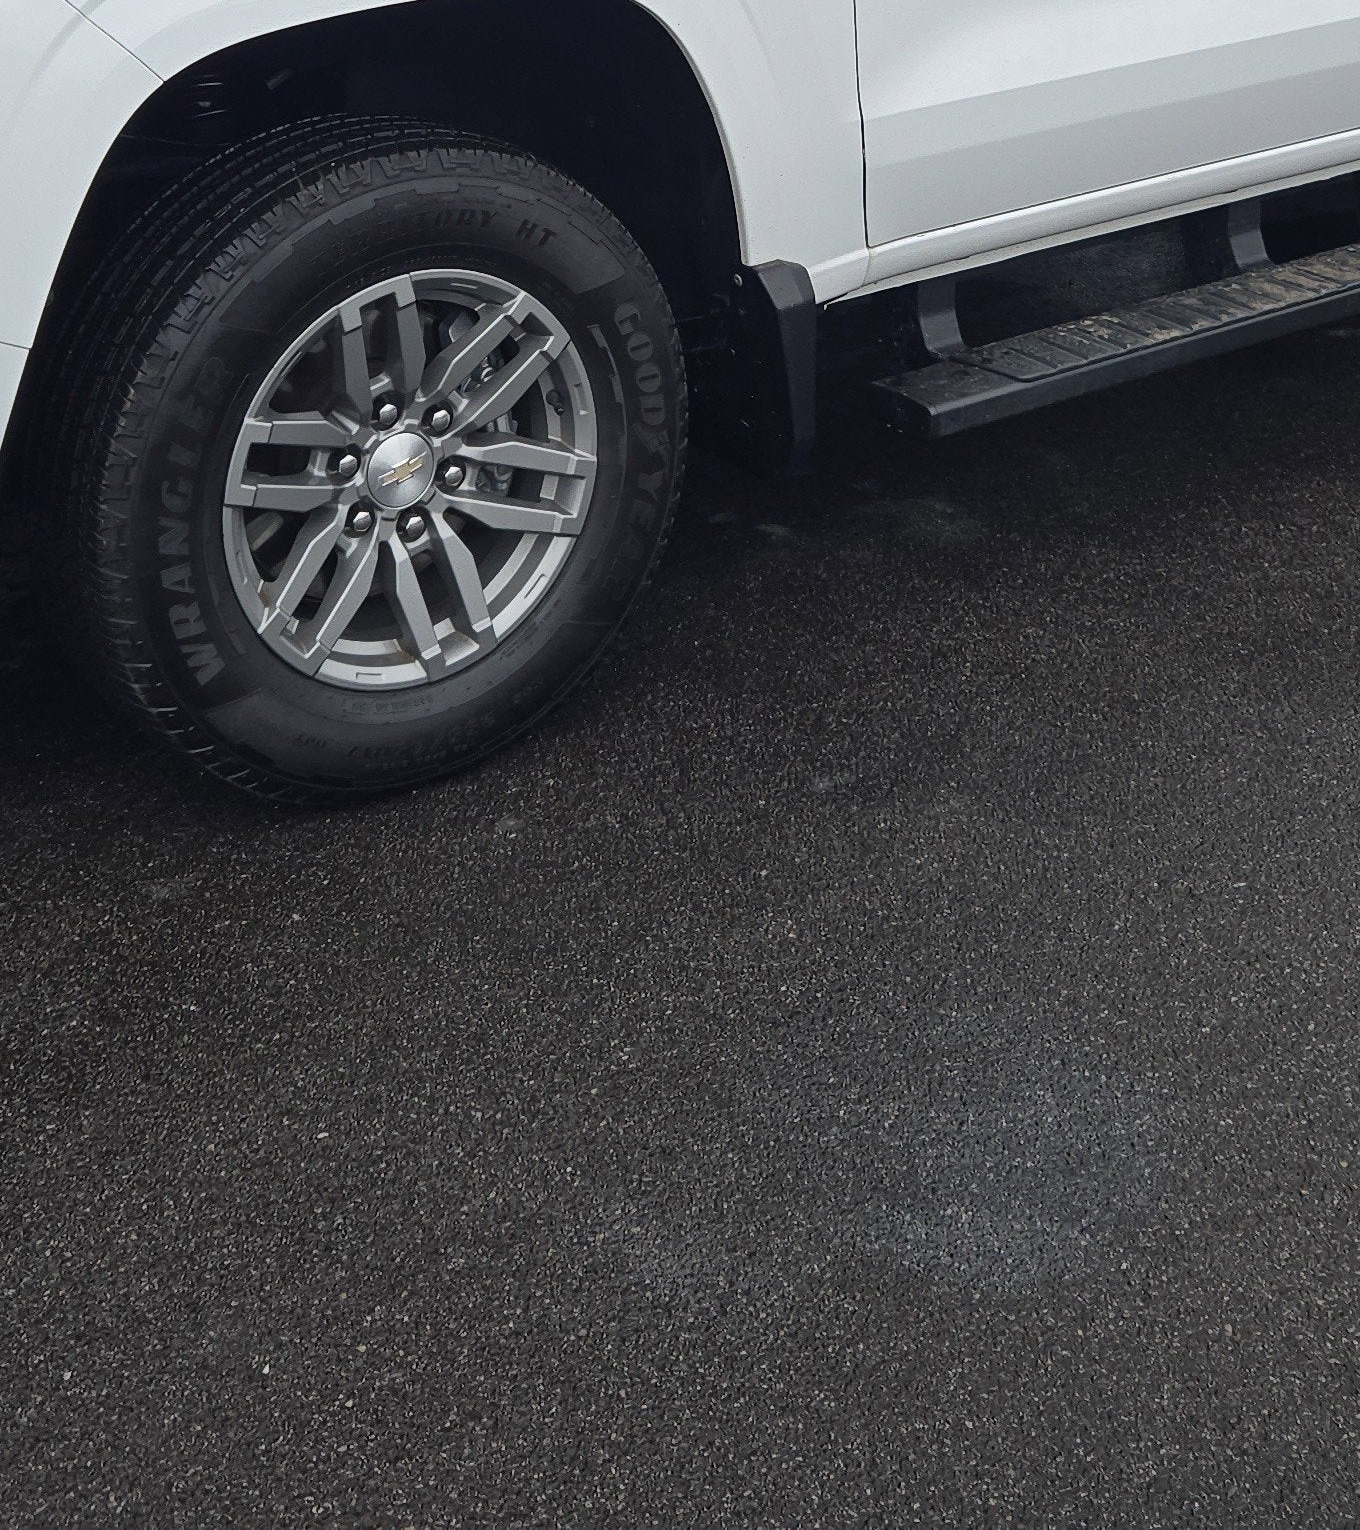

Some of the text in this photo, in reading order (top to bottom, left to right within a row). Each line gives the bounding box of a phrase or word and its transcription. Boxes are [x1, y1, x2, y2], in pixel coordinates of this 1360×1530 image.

[515, 217, 558, 247] HT
[157, 356, 233, 687] WRANGLER
[604, 302, 670, 601] GOODYEAR
